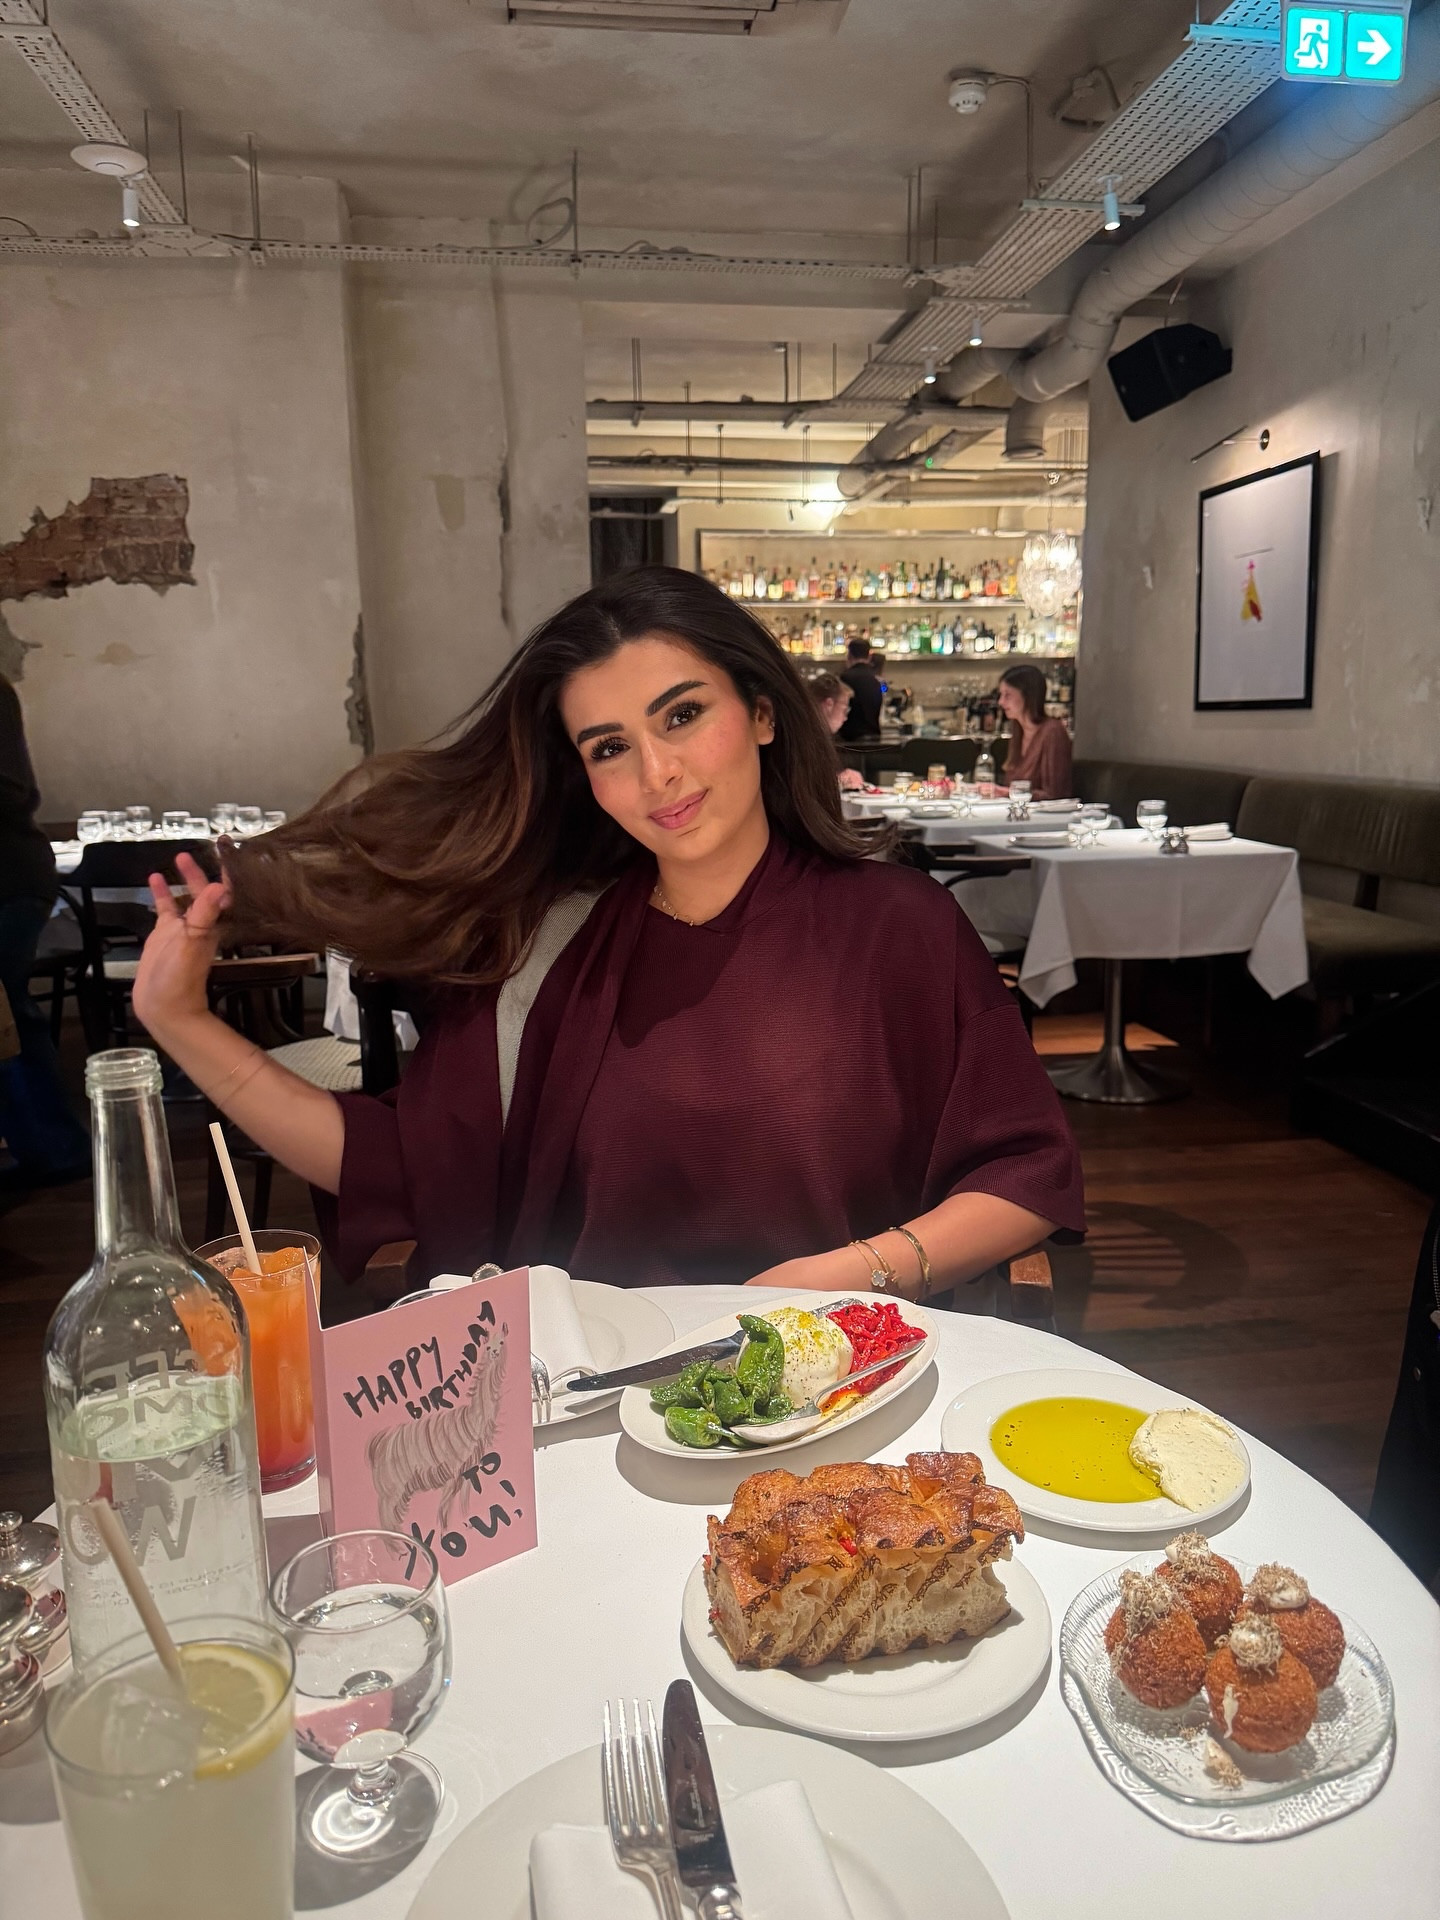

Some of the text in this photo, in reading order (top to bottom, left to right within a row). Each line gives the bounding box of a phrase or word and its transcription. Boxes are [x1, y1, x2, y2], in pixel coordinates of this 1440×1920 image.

[343, 1336, 444, 1419] HAPPY
[405, 1300, 496, 1420] BIRTHDAY
[462, 1452, 502, 1495] TO
[404, 1479, 524, 1581] YOU!
